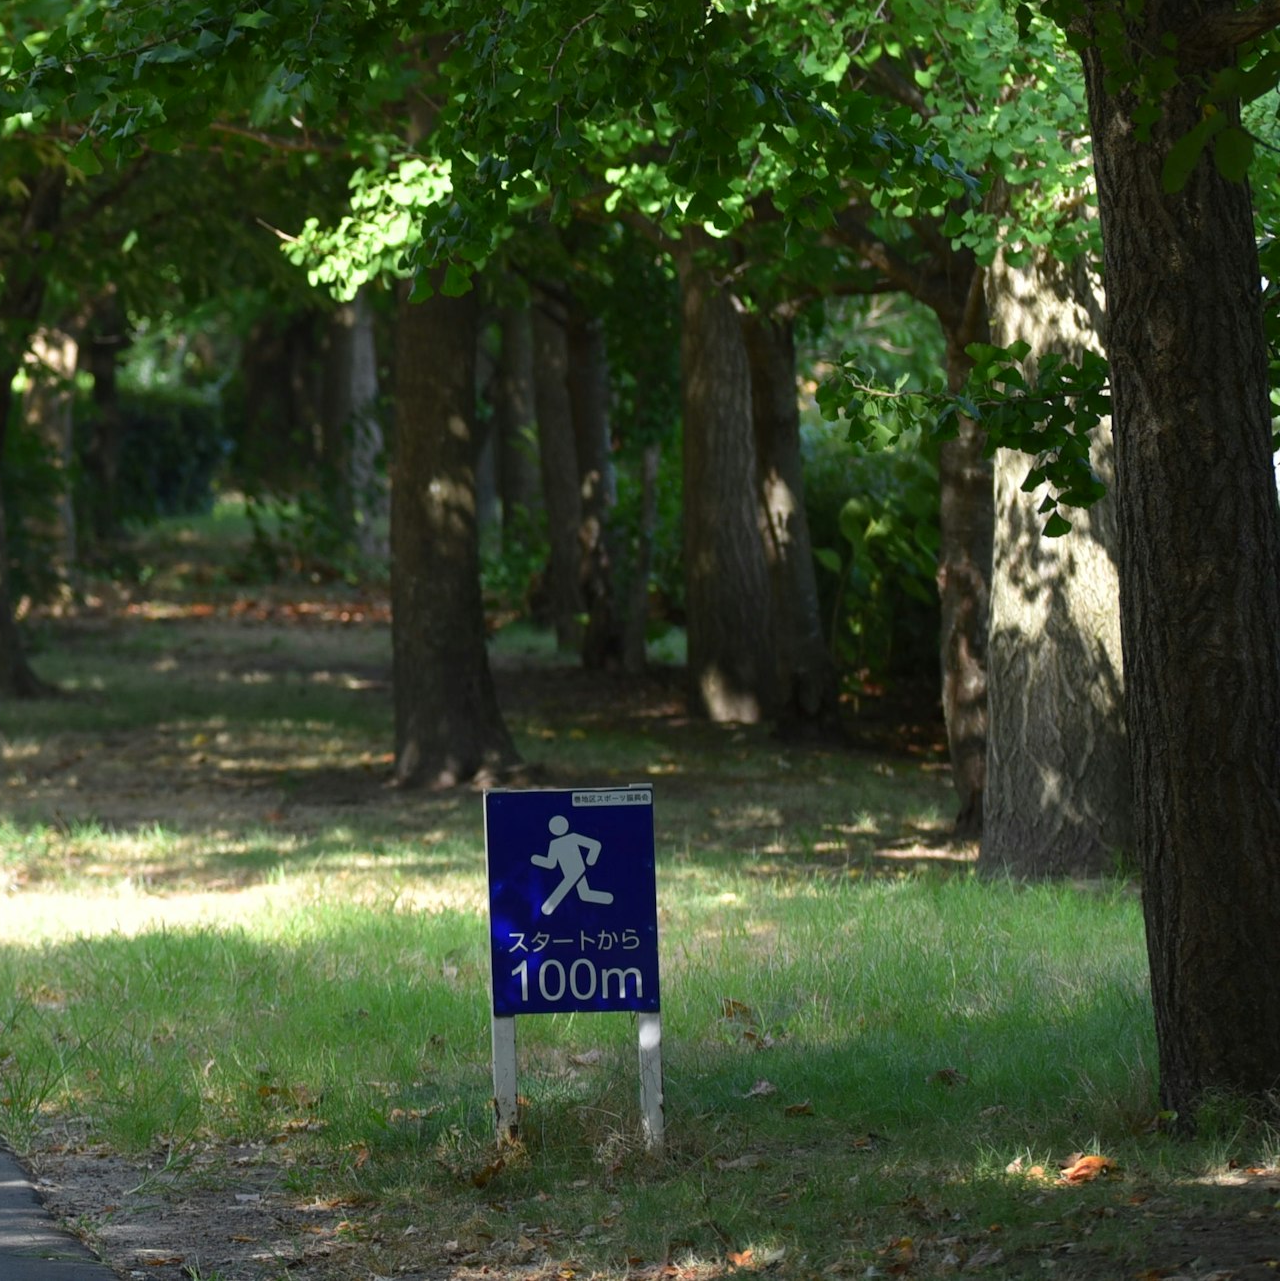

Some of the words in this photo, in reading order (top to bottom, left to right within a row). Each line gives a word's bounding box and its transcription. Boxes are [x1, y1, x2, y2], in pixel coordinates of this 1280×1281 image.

[508, 928, 641, 953] スタートから
[511, 958, 643, 1001] 100m
